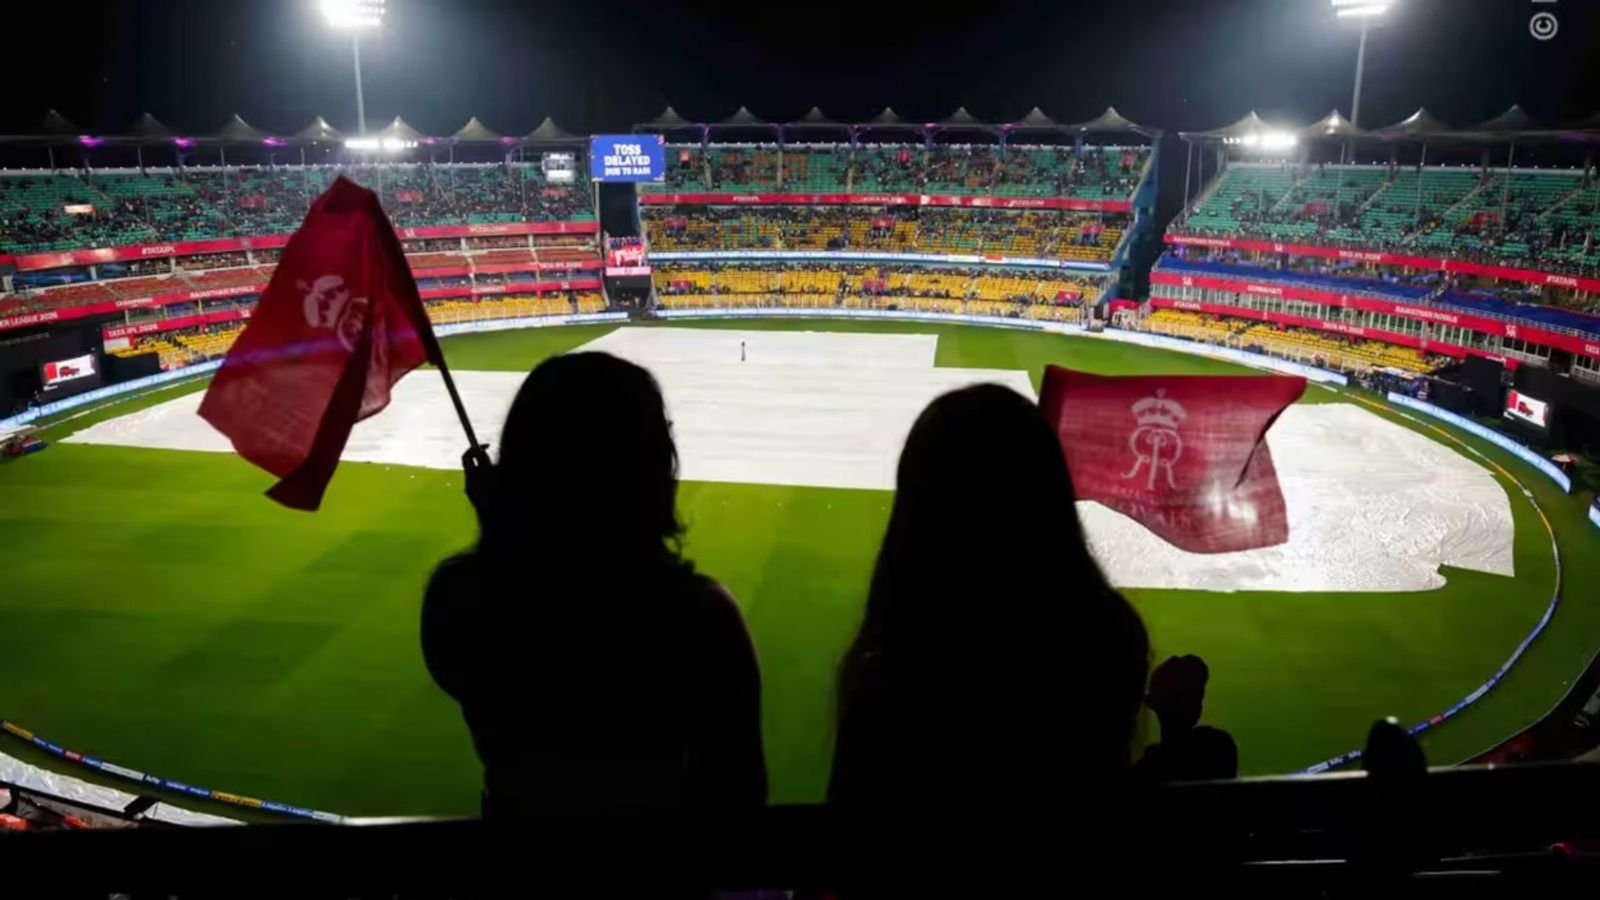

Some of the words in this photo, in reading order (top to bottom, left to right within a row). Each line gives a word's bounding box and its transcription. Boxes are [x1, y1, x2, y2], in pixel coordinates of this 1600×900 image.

[613, 144, 642, 155] TOSS
[604, 155, 651, 166] DELAYED
[605, 167, 621, 176] DUE
[622, 167, 632, 175] TO
[10, 314, 38, 327] LEAGUE
[108, 329, 127, 338] TATA
[127, 326, 138, 334] IPL
